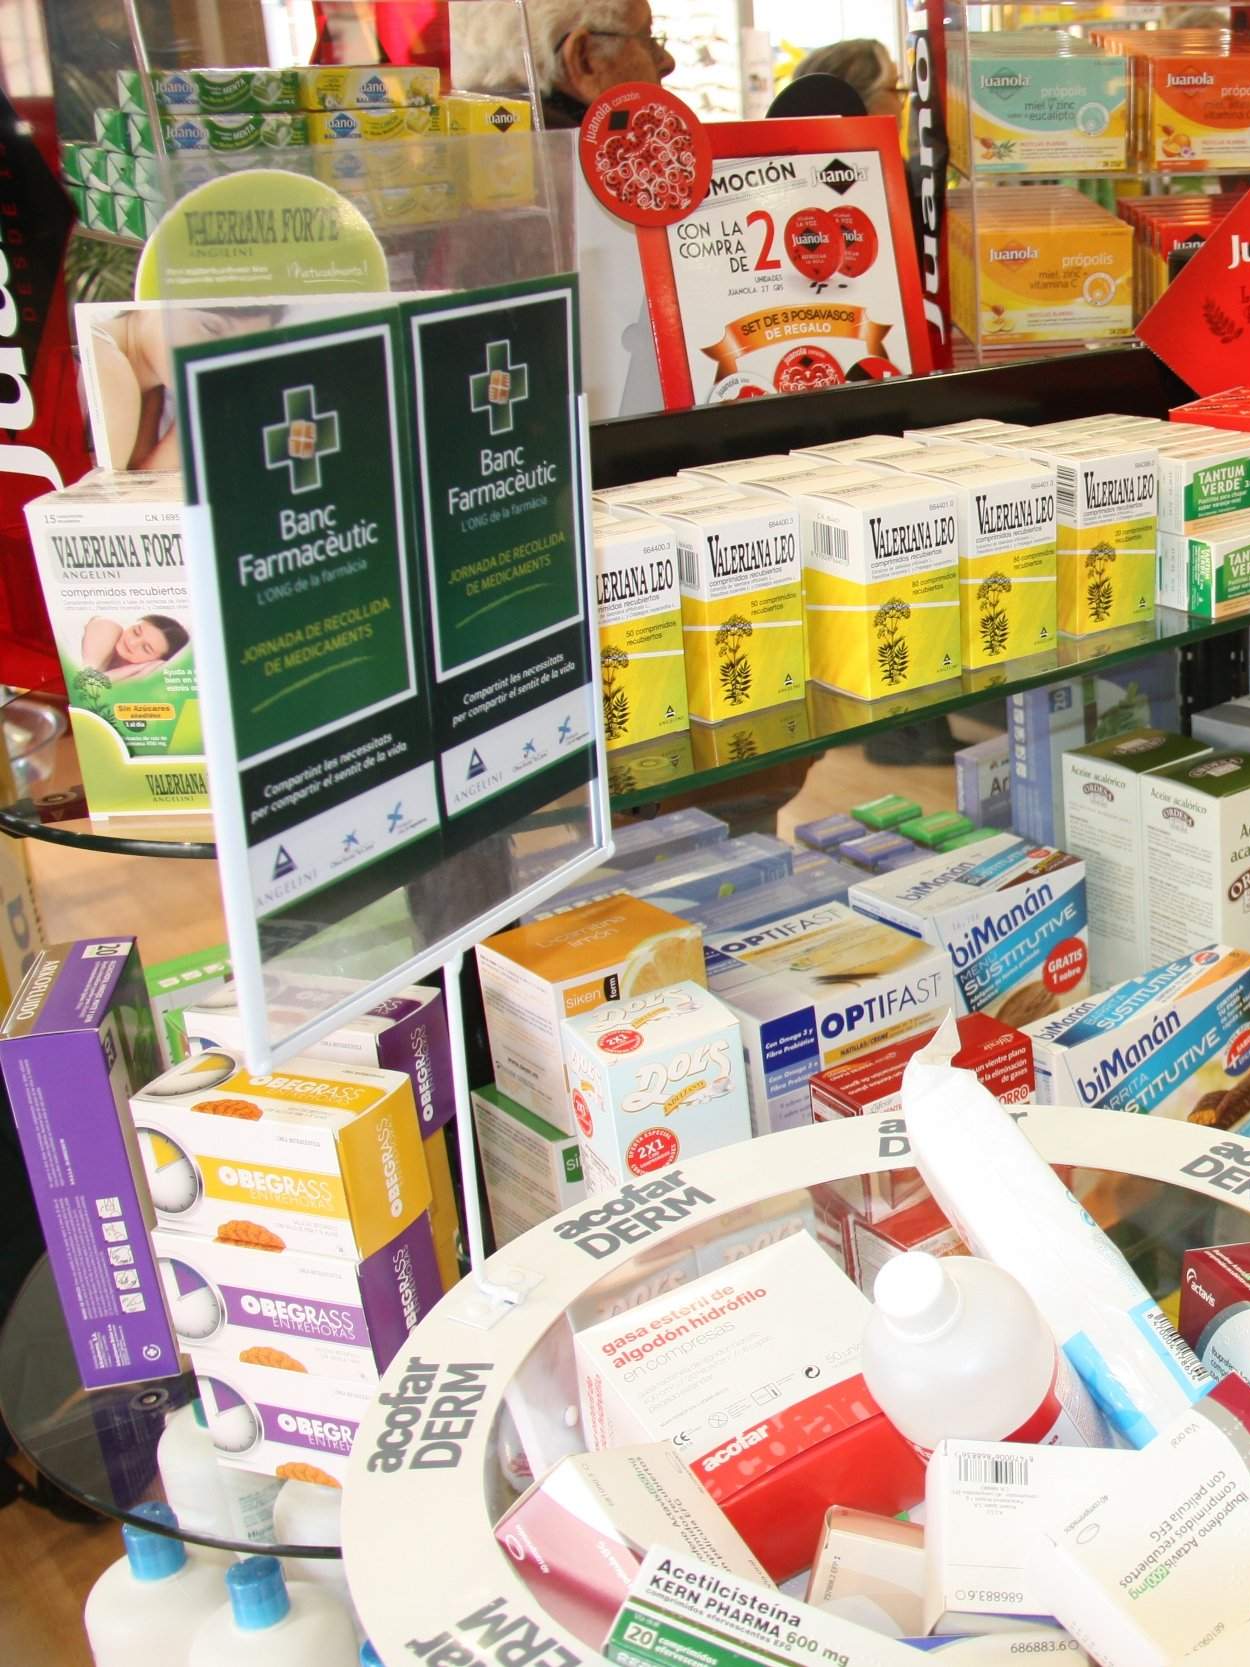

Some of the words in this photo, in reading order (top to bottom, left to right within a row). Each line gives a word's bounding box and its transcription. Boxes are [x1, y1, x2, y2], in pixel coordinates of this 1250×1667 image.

[702, 161, 798, 199] MOCIÓN
[676, 223, 711, 240] CON
[721, 220, 744, 237] LA
[679, 239, 747, 260] COMPRA
[745, 210, 783, 272] 2
[728, 257, 750, 274] DE
[1062, 252, 1115, 269] própolis
[741, 320, 762, 337] SET
[763, 315, 781, 329] DE
[781, 311, 790, 324] 3
[790, 308, 856, 324] POSAVASOS
[765, 325, 783, 341] DE
[783, 322, 832, 336] REGALO
[480, 446, 525, 477] Banc
[1197, 464, 1246, 485] TANTUM
[448, 459, 558, 516] Farmacèutic
[1083, 471, 1135, 510] VALERIANA
[1136, 473, 1155, 501] LEO
[1200, 478, 1241, 497] VERDE
[279, 504, 337, 542] Banc
[975, 494, 1034, 535] VALERIANA
[1034, 495, 1055, 524] LEO
[237, 519, 380, 587] Farmacèutic
[447, 554, 499, 585] JORNADA
[499, 550, 513, 566] DE
[512, 530, 567, 561] RECOLLIDA
[706, 534, 774, 578] VALERIANA
[773, 533, 796, 565] LEO
[869, 517, 934, 559] VALERIANA
[934, 515, 956, 546] LEO
[61, 570, 121, 581] ANGELINI
[61, 586, 128, 602] comprimidos
[128, 585, 188, 597] recubiertos
[465, 582, 481, 597] DE
[480, 553, 552, 594] MEDICAMENTS
[240, 628, 305, 666] JORNADA
[304, 621, 323, 641] DE
[323, 597, 392, 634] RECOLLIDA
[750, 603, 784, 616] recubiertos
[263, 658, 283, 678] DE
[283, 622, 374, 670] MEDICAMENTS
[626, 632, 664, 647] recubiertos
[452, 713, 469, 729] per
[468, 692, 509, 718] compartir
[508, 689, 517, 700] el
[517, 676, 541, 696] sentit
[540, 672, 552, 684] de
[551, 667, 560, 679] la
[559, 661, 576, 676] vida
[463, 677, 510, 706] Compartint
[509, 672, 523, 686] les
[522, 653, 565, 679] necessitats
[145, 773, 209, 796] VALERIANA
[250, 806, 270, 826] per
[270, 779, 323, 813] compartir
[322, 773, 334, 789] el
[333, 760, 364, 784] sentit
[363, 755, 377, 770] de
[376, 747, 388, 763] la
[387, 740, 408, 759] vida
[263, 763, 323, 799] Compartint
[322, 757, 339, 776] les
[339, 732, 393, 764] necessitats
[720, 908, 843, 954] OPTIFAST
[948, 882, 1054, 969] biManán
[95, 944, 121, 956] 20
[964, 901, 1078, 997] SUSTITUTIVE
[1047, 948, 1084, 974] GRATIS
[16, 959, 61, 1021] ARKOFLUIDO
[565, 986, 602, 1010] siken
[609, 976, 618, 1001] form
[820, 970, 942, 1040] OPTIFAST
[1096, 960, 1188, 1032] SUSTITUTIVE
[410, 1026, 434, 1122] OBEGRASS
[1076, 1009, 1183, 1106] biManán
[249, 1075, 365, 1101] OBEGRASS
[376, 1117, 403, 1218] OBEGRASS
[637, 1137, 666, 1160] 2X1
[218, 1165, 335, 1202] OBEGRASS
[553, 1169, 689, 1241] acofar
[573, 1184, 719, 1260] DERM
[240, 1294, 354, 1331] OBEGRASS
[1189, 1280, 1217, 1308] actavis
[612, 1321, 691, 1370] algodón
[691, 1286, 768, 1330] hidrófilo
[622, 1366, 647, 1384] en
[646, 1320, 738, 1374] compresas
[366, 1356, 441, 1474] acofar
[409, 1362, 495, 1471] DERM
[703, 1423, 770, 1472] acofar
[1205, 1469, 1227, 1491] con
[1149, 1519, 1173, 1542] EFG
[1178, 1480, 1238, 1541] comprimidos
[1199, 1491, 1250, 1540] Ibuprofeno
[1118, 1535, 1177, 1590] recubiertos
[1166, 1537, 1200, 1571] Actavis
[656, 1558, 803, 1628] Acetilcisteína
[645, 1588, 704, 1616] comprimidos
[706, 1612, 772, 1644] efervescentes
[649, 1574, 702, 1606] KERN
[703, 1596, 781, 1639] PHARMA
[785, 1630, 819, 1653] 600
[822, 1647, 850, 1667] mg
[625, 1624, 653, 1648] 20
[657, 1636, 718, 1666] comprimidos
[1010, 1640, 1067, 1655] 686883.6
